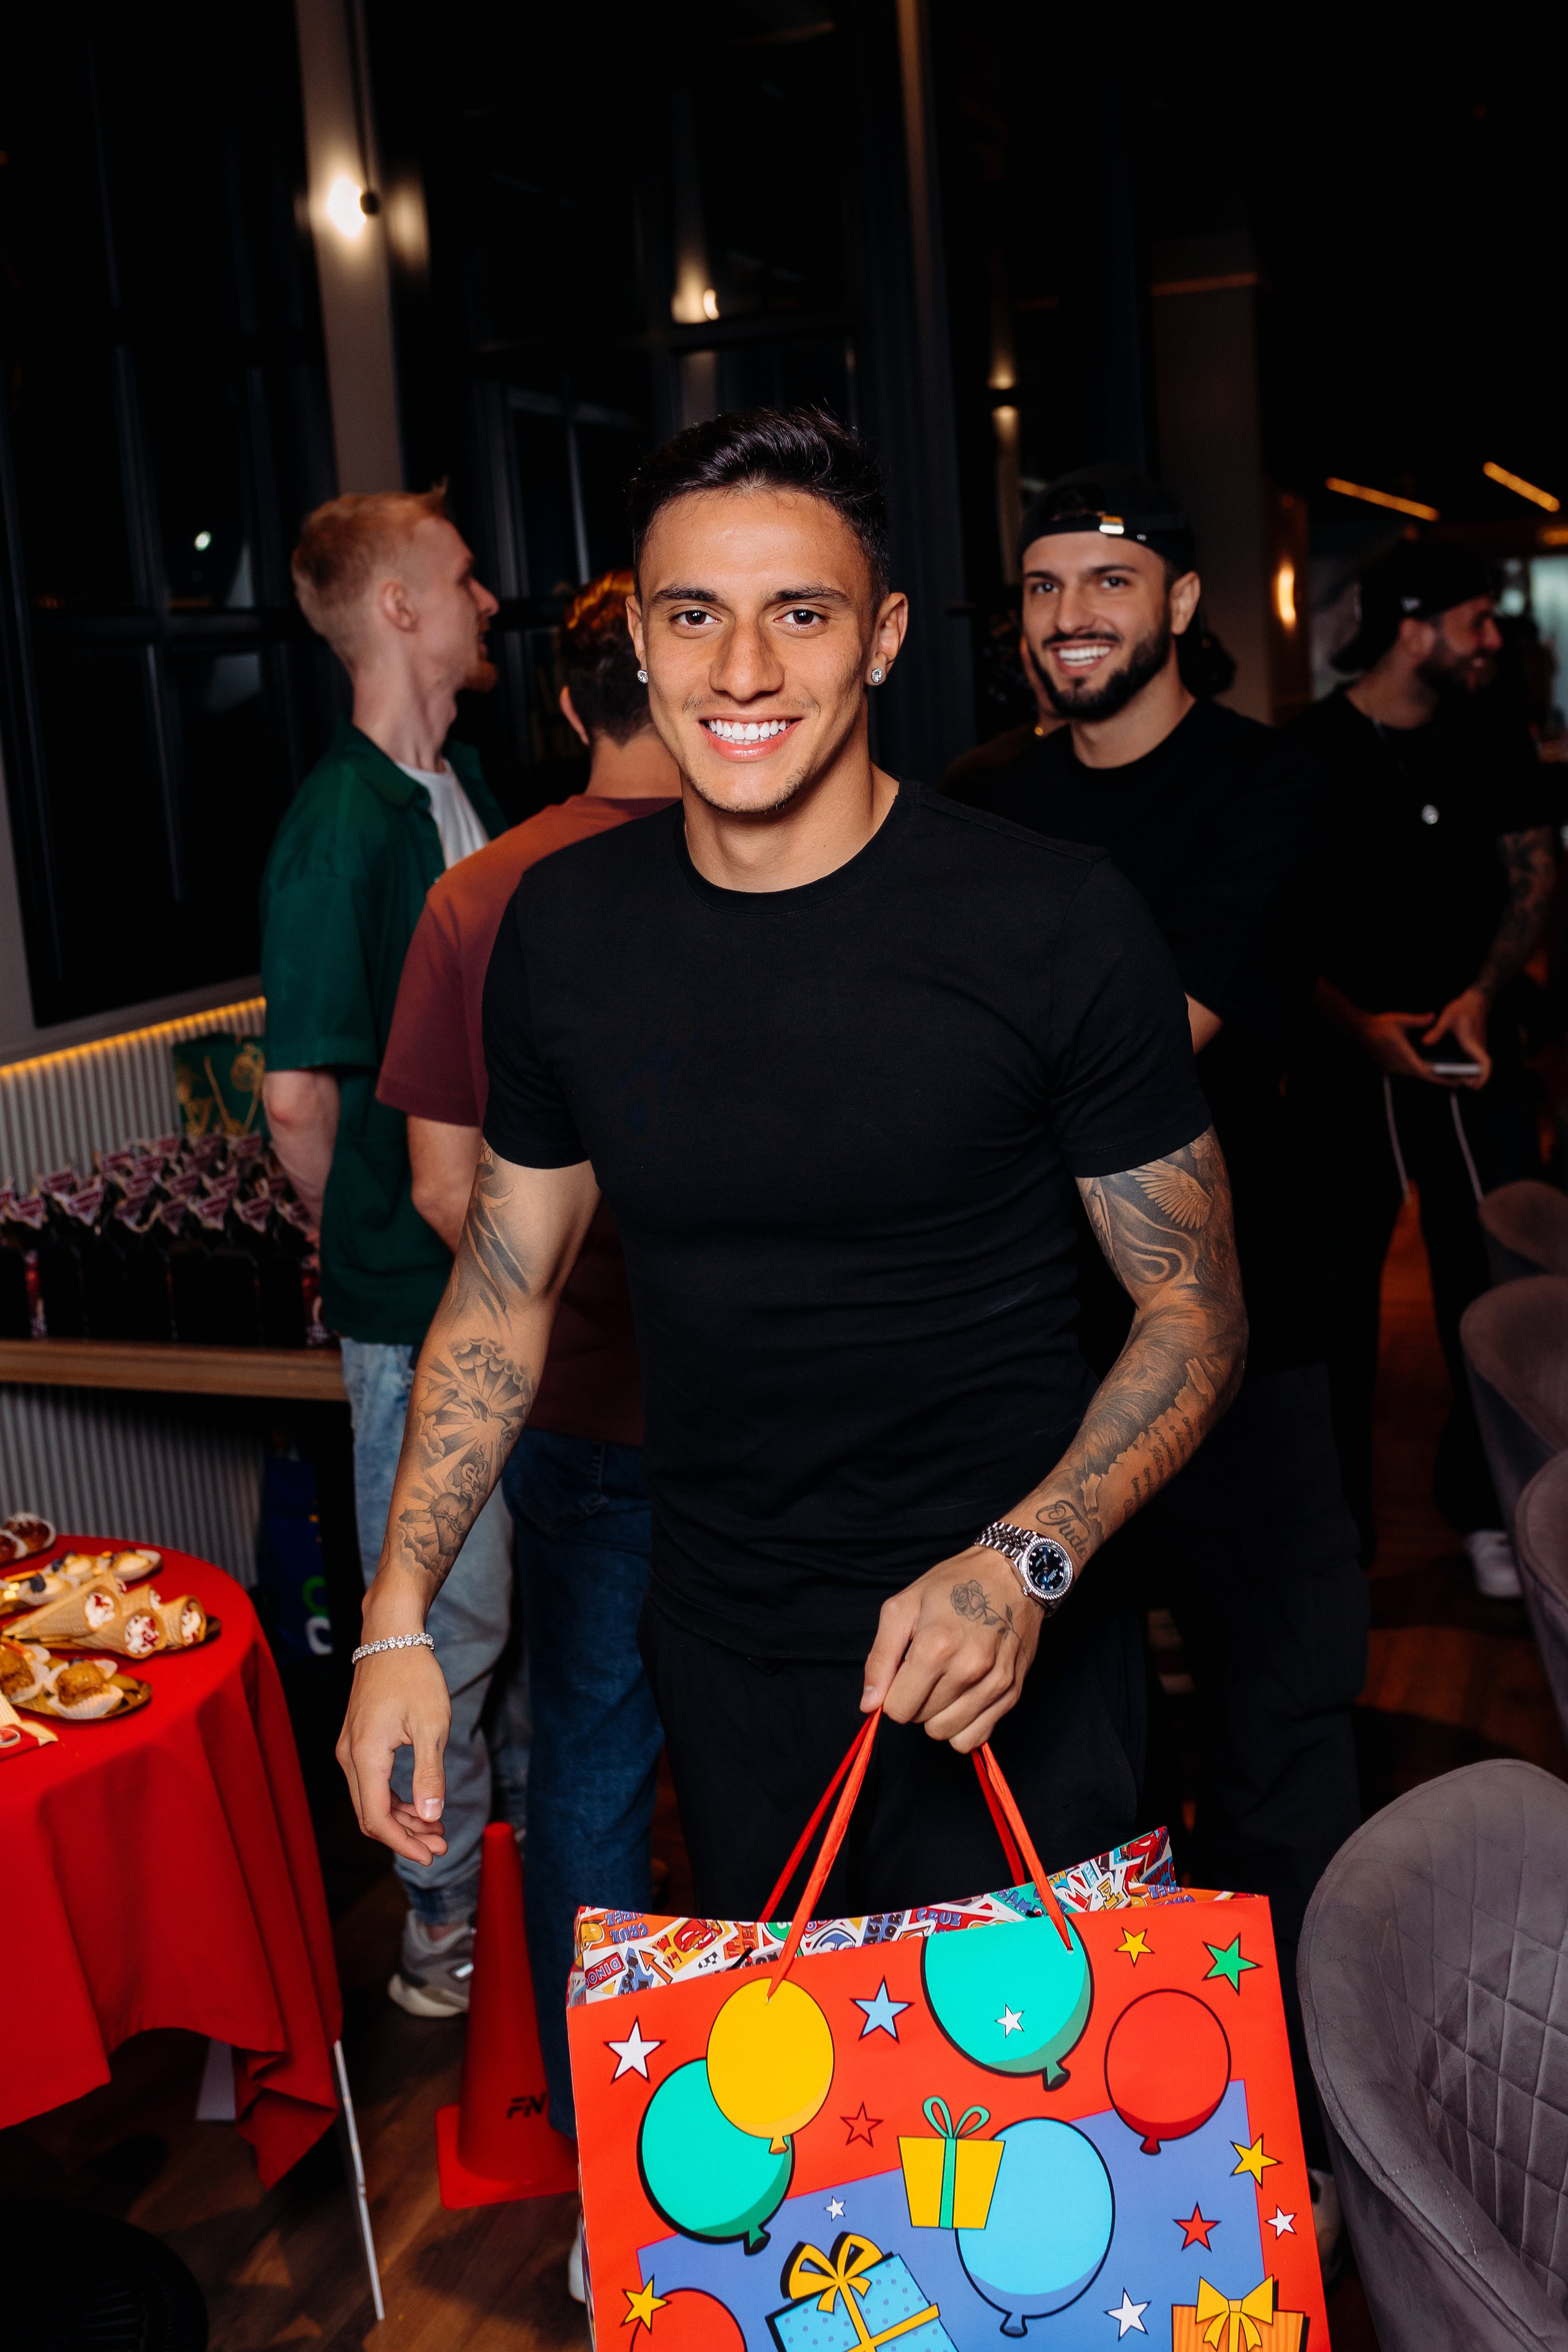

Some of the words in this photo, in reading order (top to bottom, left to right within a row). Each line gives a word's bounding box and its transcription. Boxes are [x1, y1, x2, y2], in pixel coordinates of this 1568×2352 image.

[1035, 1500, 1090, 1559] Tudo
[916, 1907, 962, 1927] CRUZ
[609, 1923, 648, 1944] CRUZ
[586, 1957, 620, 1985] DINO
[507, 2093, 546, 2119] FN
